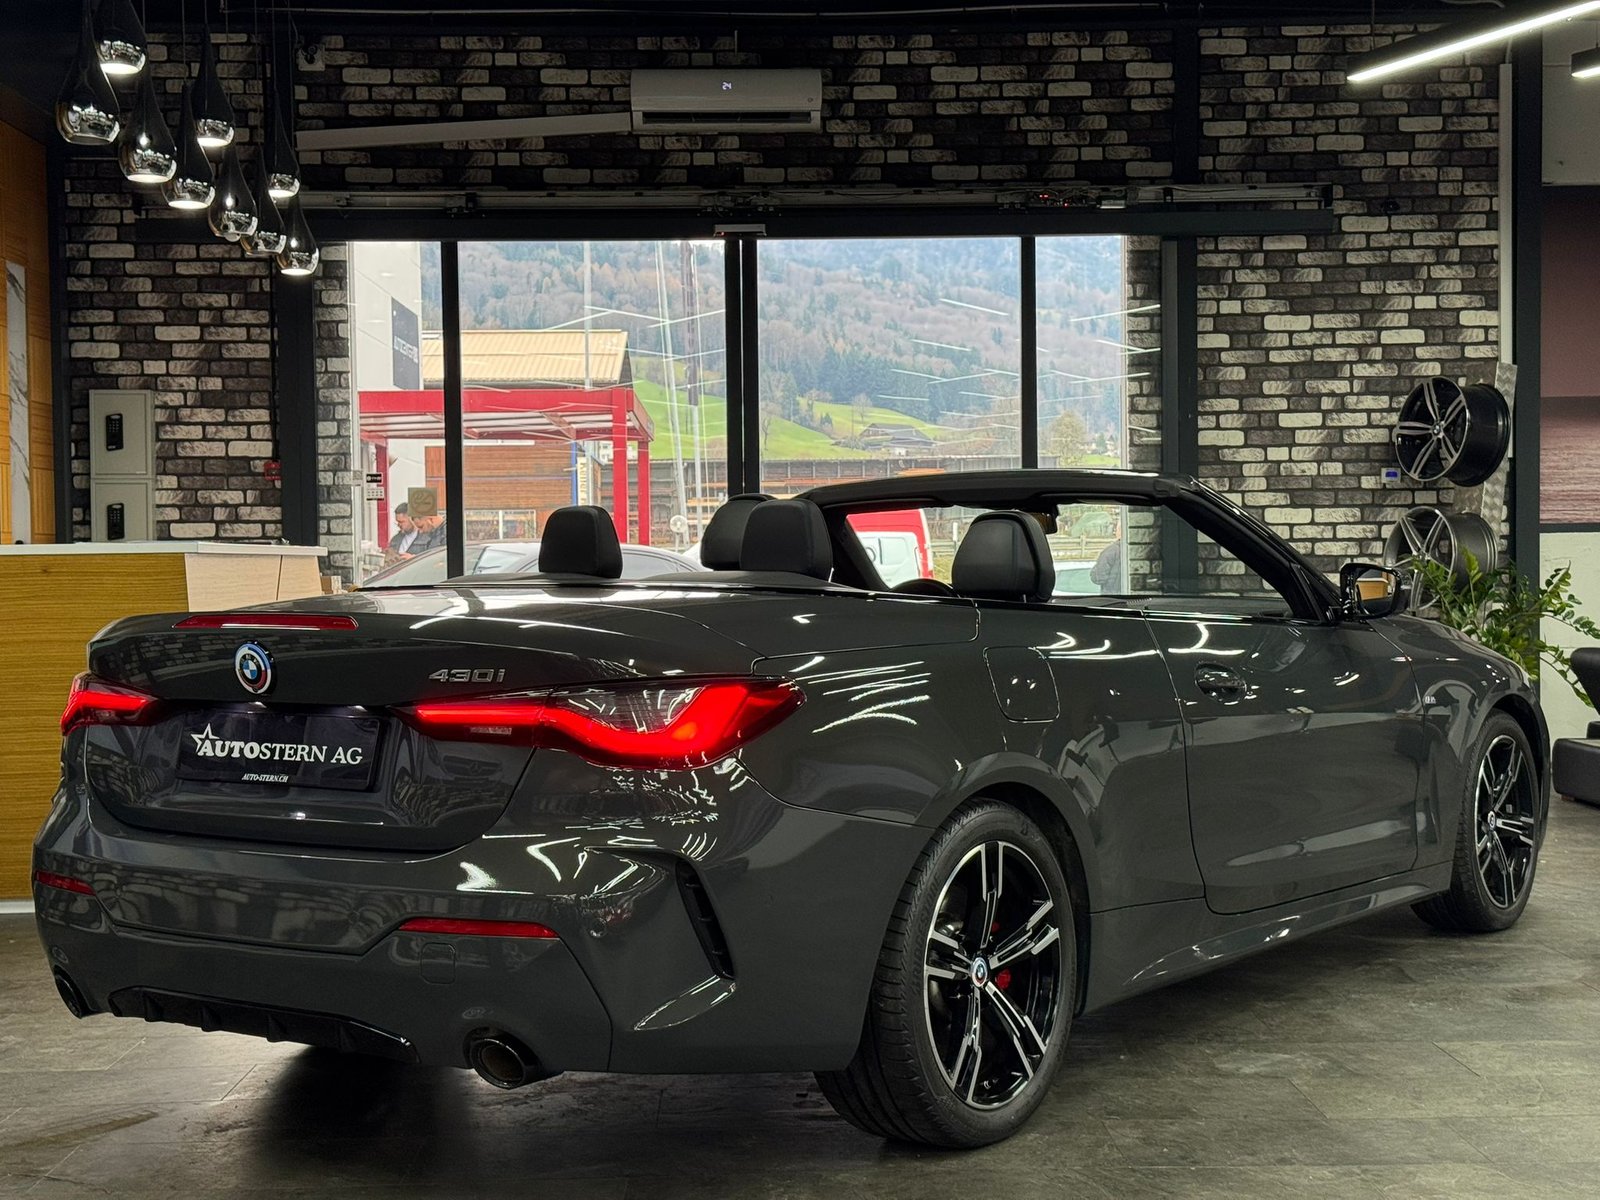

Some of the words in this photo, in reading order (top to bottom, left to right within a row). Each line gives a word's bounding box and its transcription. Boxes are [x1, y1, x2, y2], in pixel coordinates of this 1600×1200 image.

[428, 668, 506, 682] 430i
[197, 739, 328, 763] AUTOSTERN
[330, 746, 363, 765] AG
[241, 773, 289, 783] AUTO-STERN.CH
